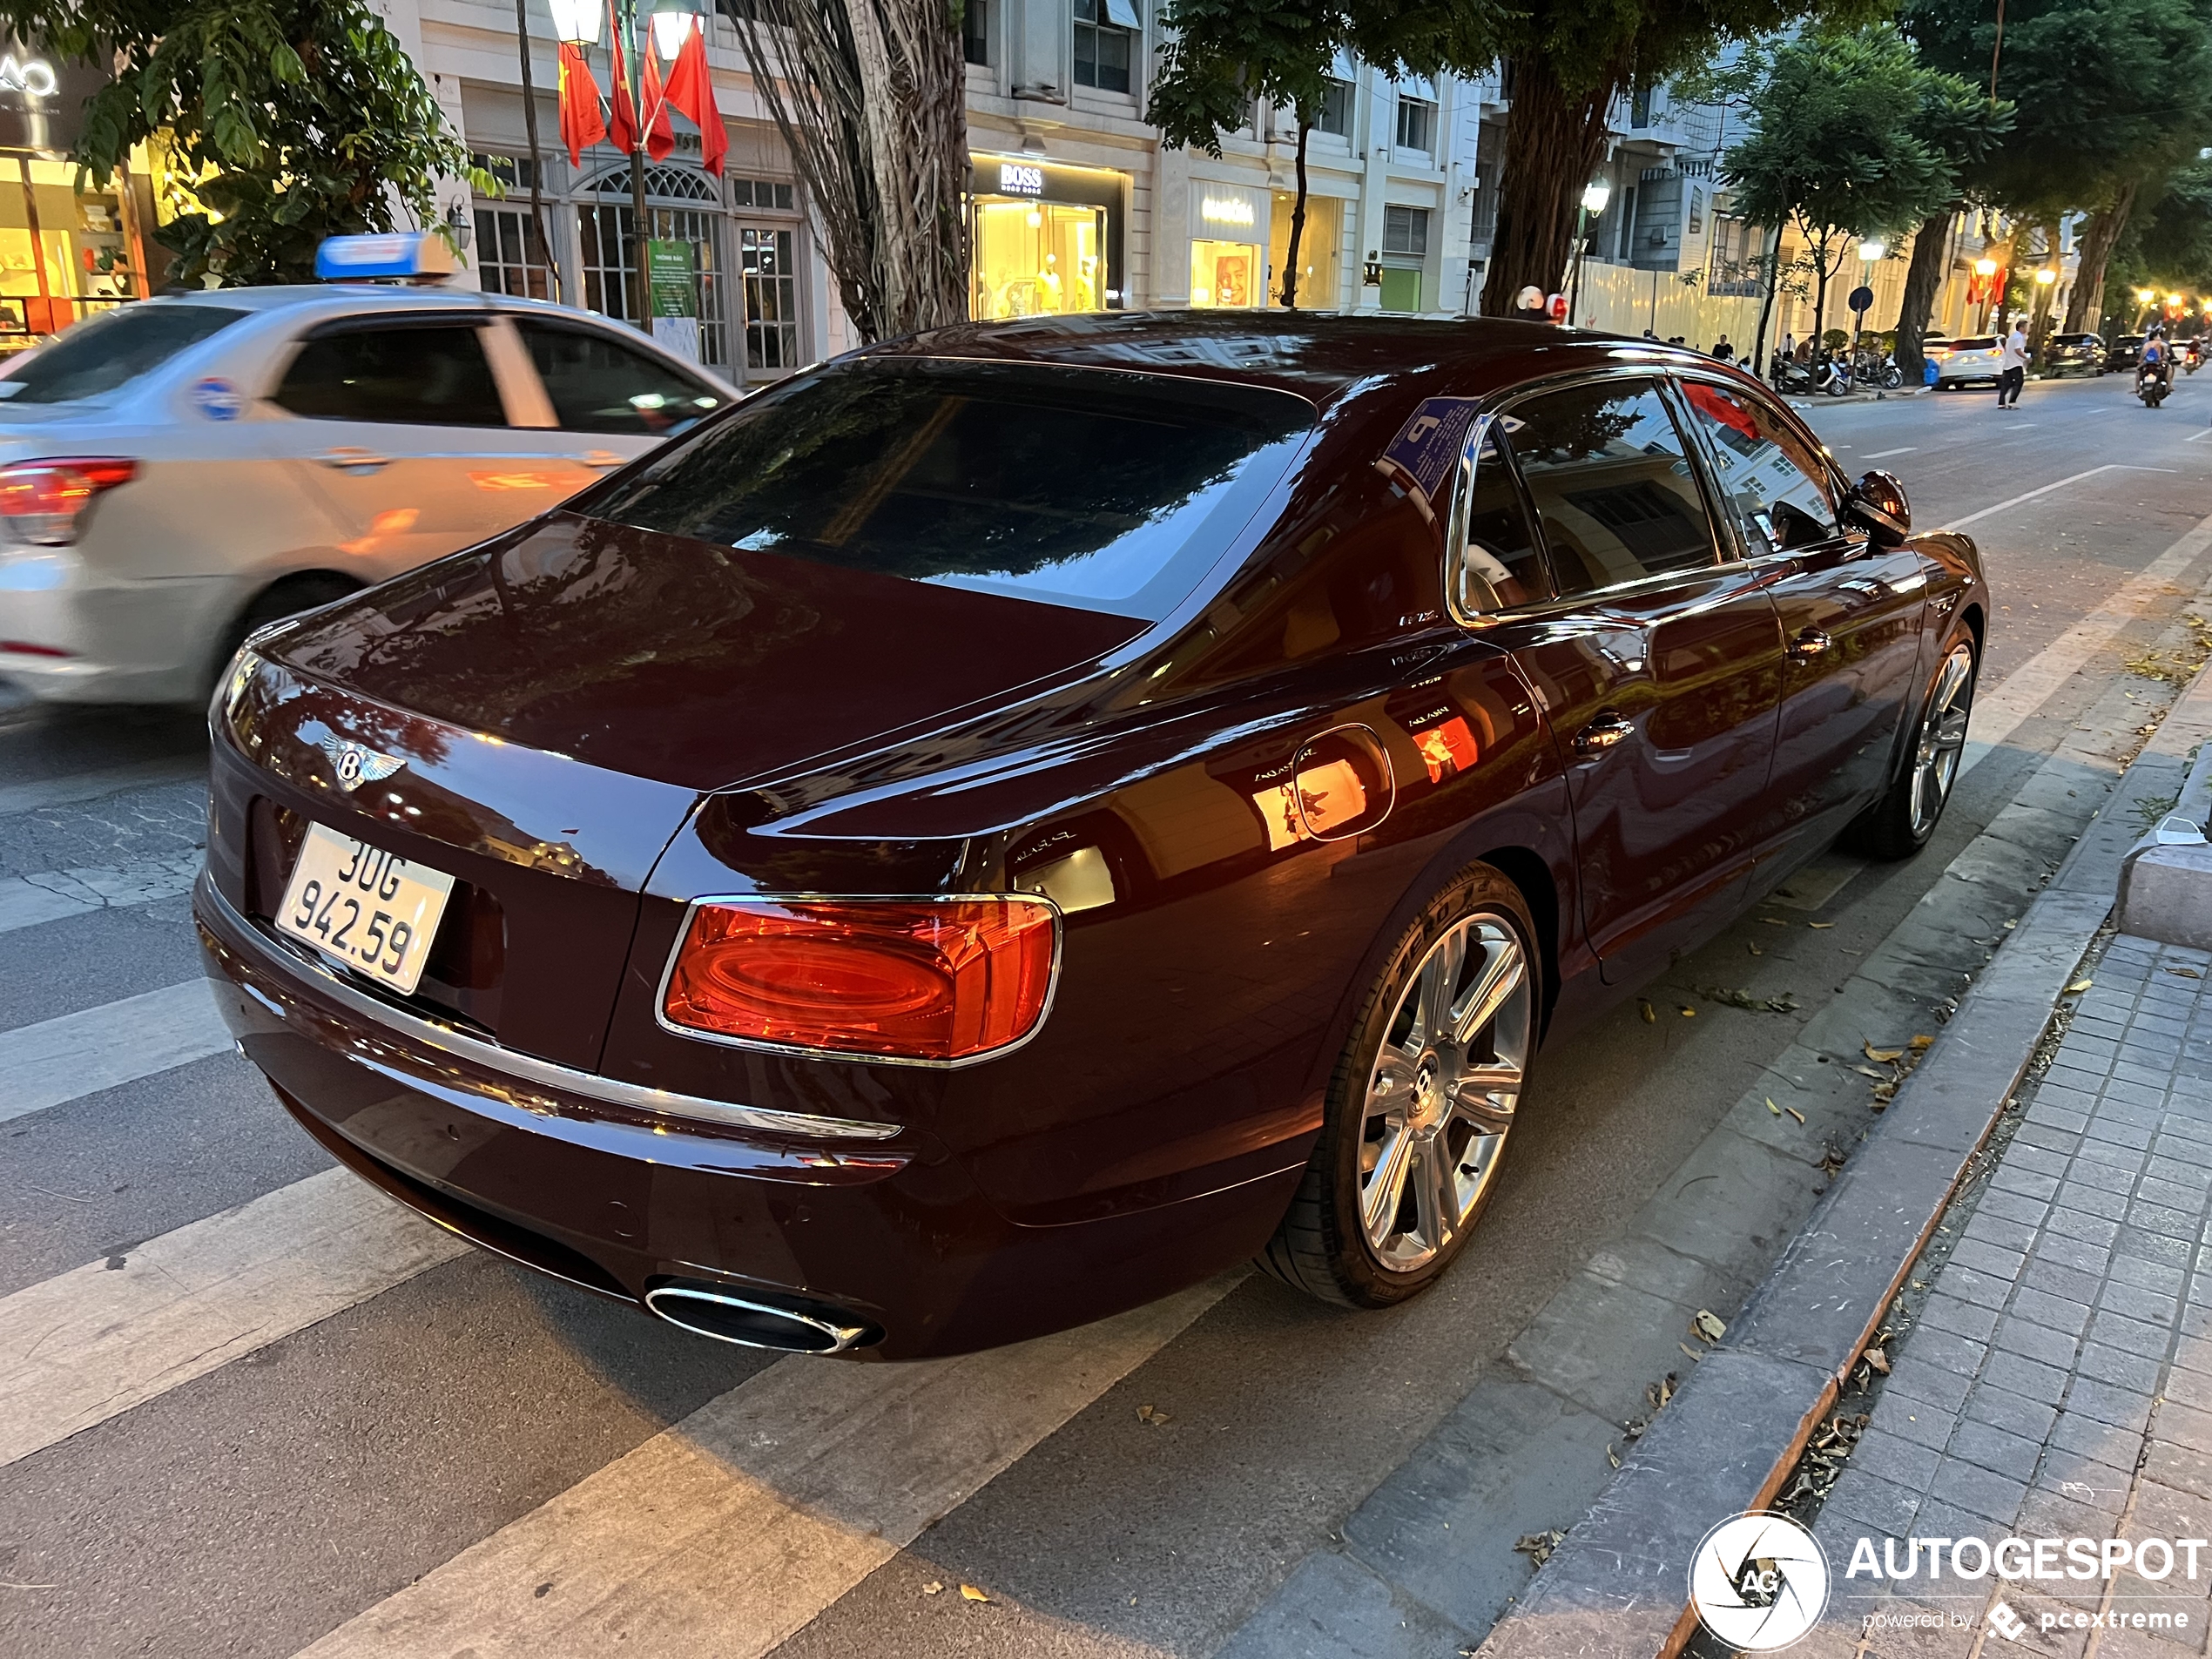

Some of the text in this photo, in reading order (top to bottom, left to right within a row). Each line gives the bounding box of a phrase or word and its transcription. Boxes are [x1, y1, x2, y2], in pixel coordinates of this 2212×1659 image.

[1001, 164, 1042, 188] BOSS
[338, 837, 407, 901] 30G
[294, 880, 413, 975] 942.59
[1396, 901, 1450, 982] ZERO
